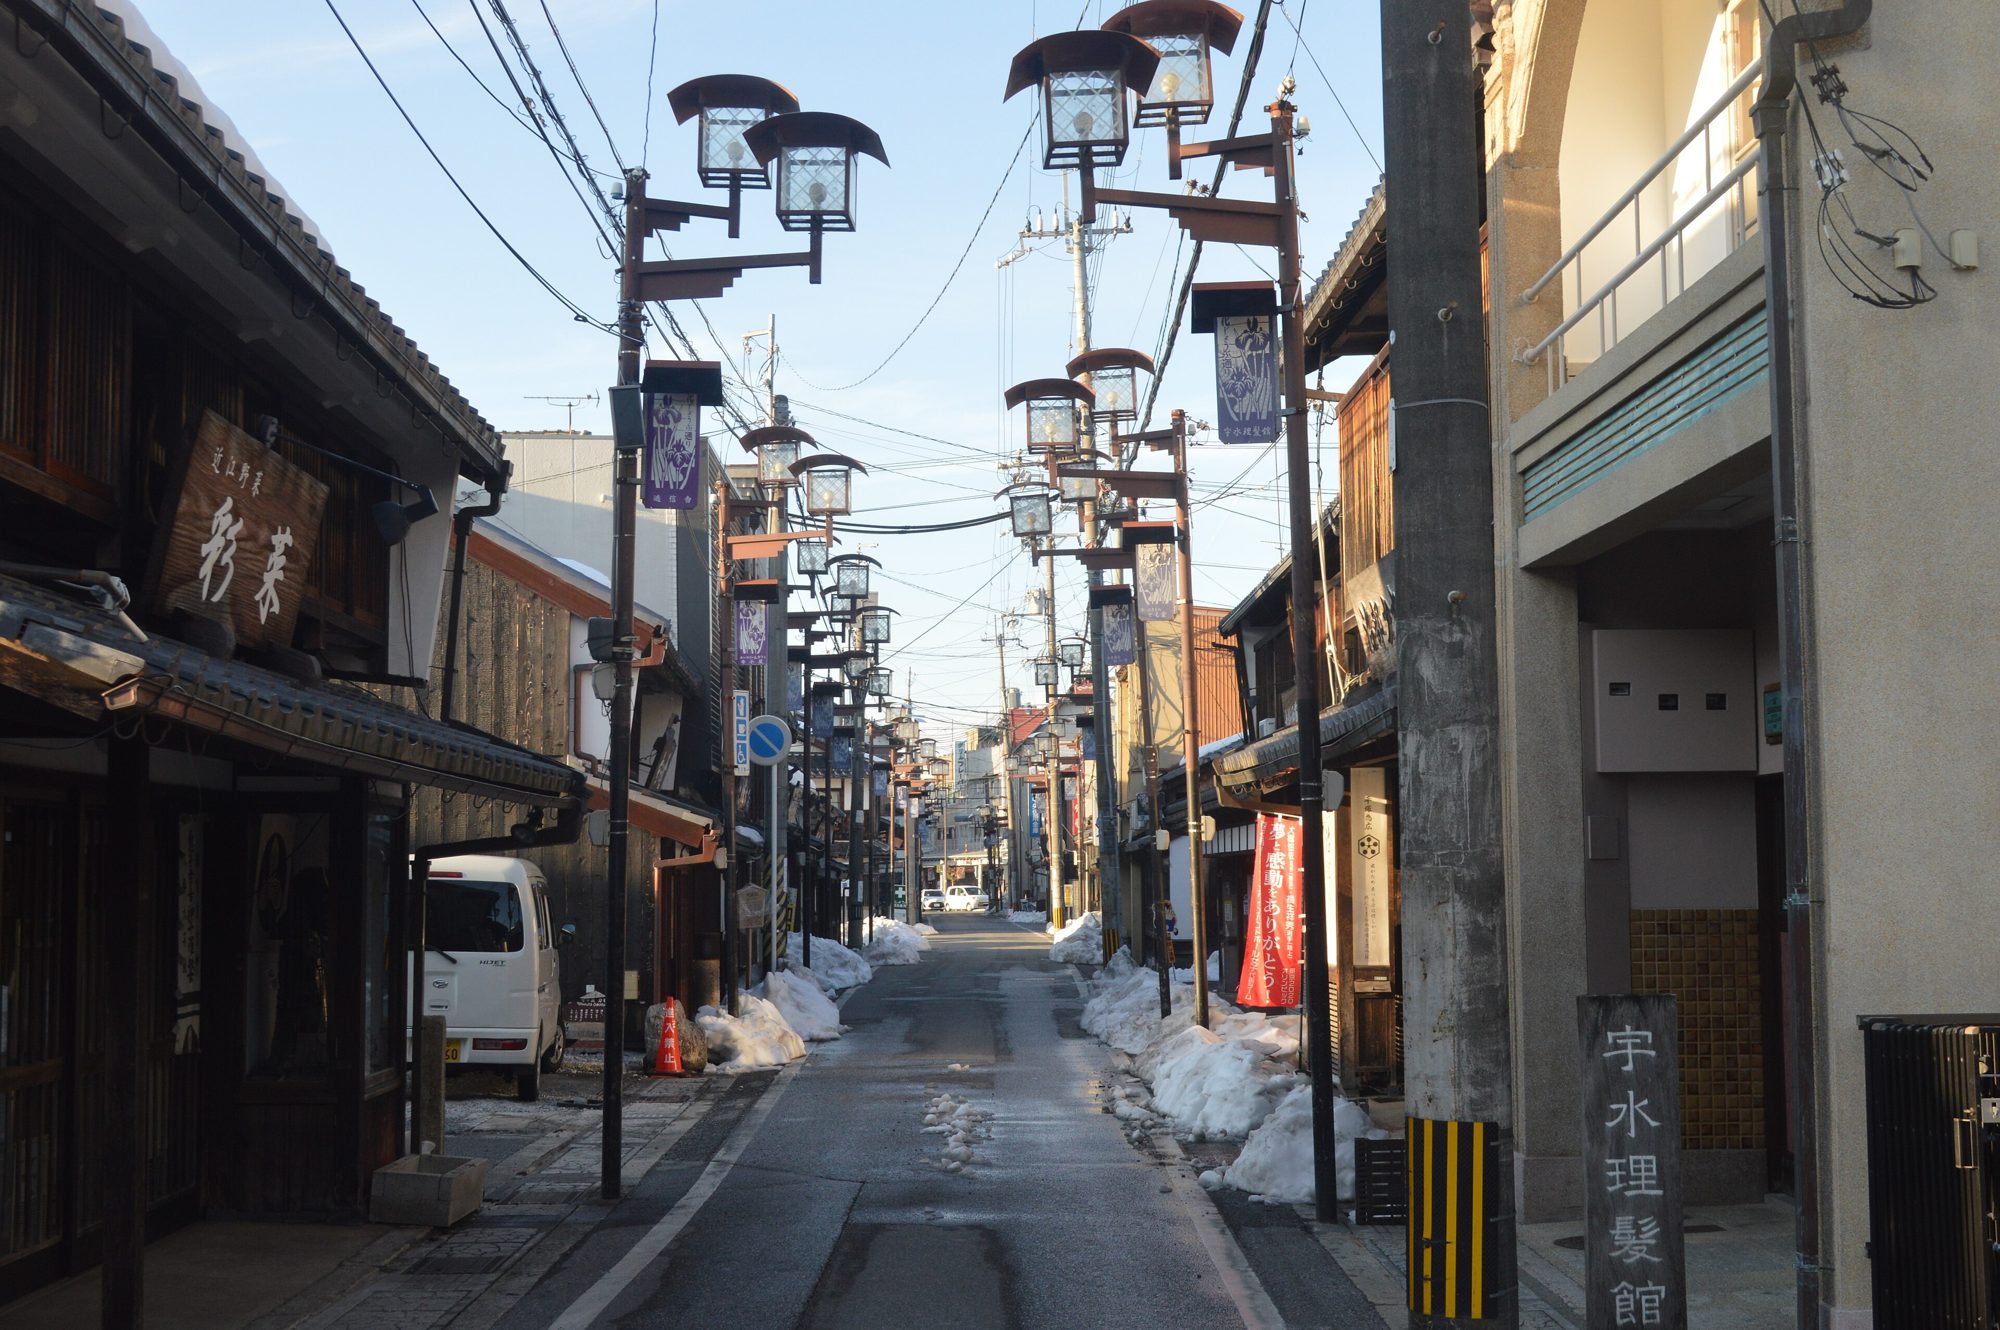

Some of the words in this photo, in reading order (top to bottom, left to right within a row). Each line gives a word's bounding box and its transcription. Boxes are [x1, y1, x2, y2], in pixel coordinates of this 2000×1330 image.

[1224, 426, 1271, 437] 宇水理髪館
[1264, 822, 1286, 1004] 夢と感動をありがとう!
[1288, 967, 1296, 1005] 東京2020
[663, 1007, 675, 1063] 進入禁止
[1602, 1024, 1666, 1326] 宇水理髪館
